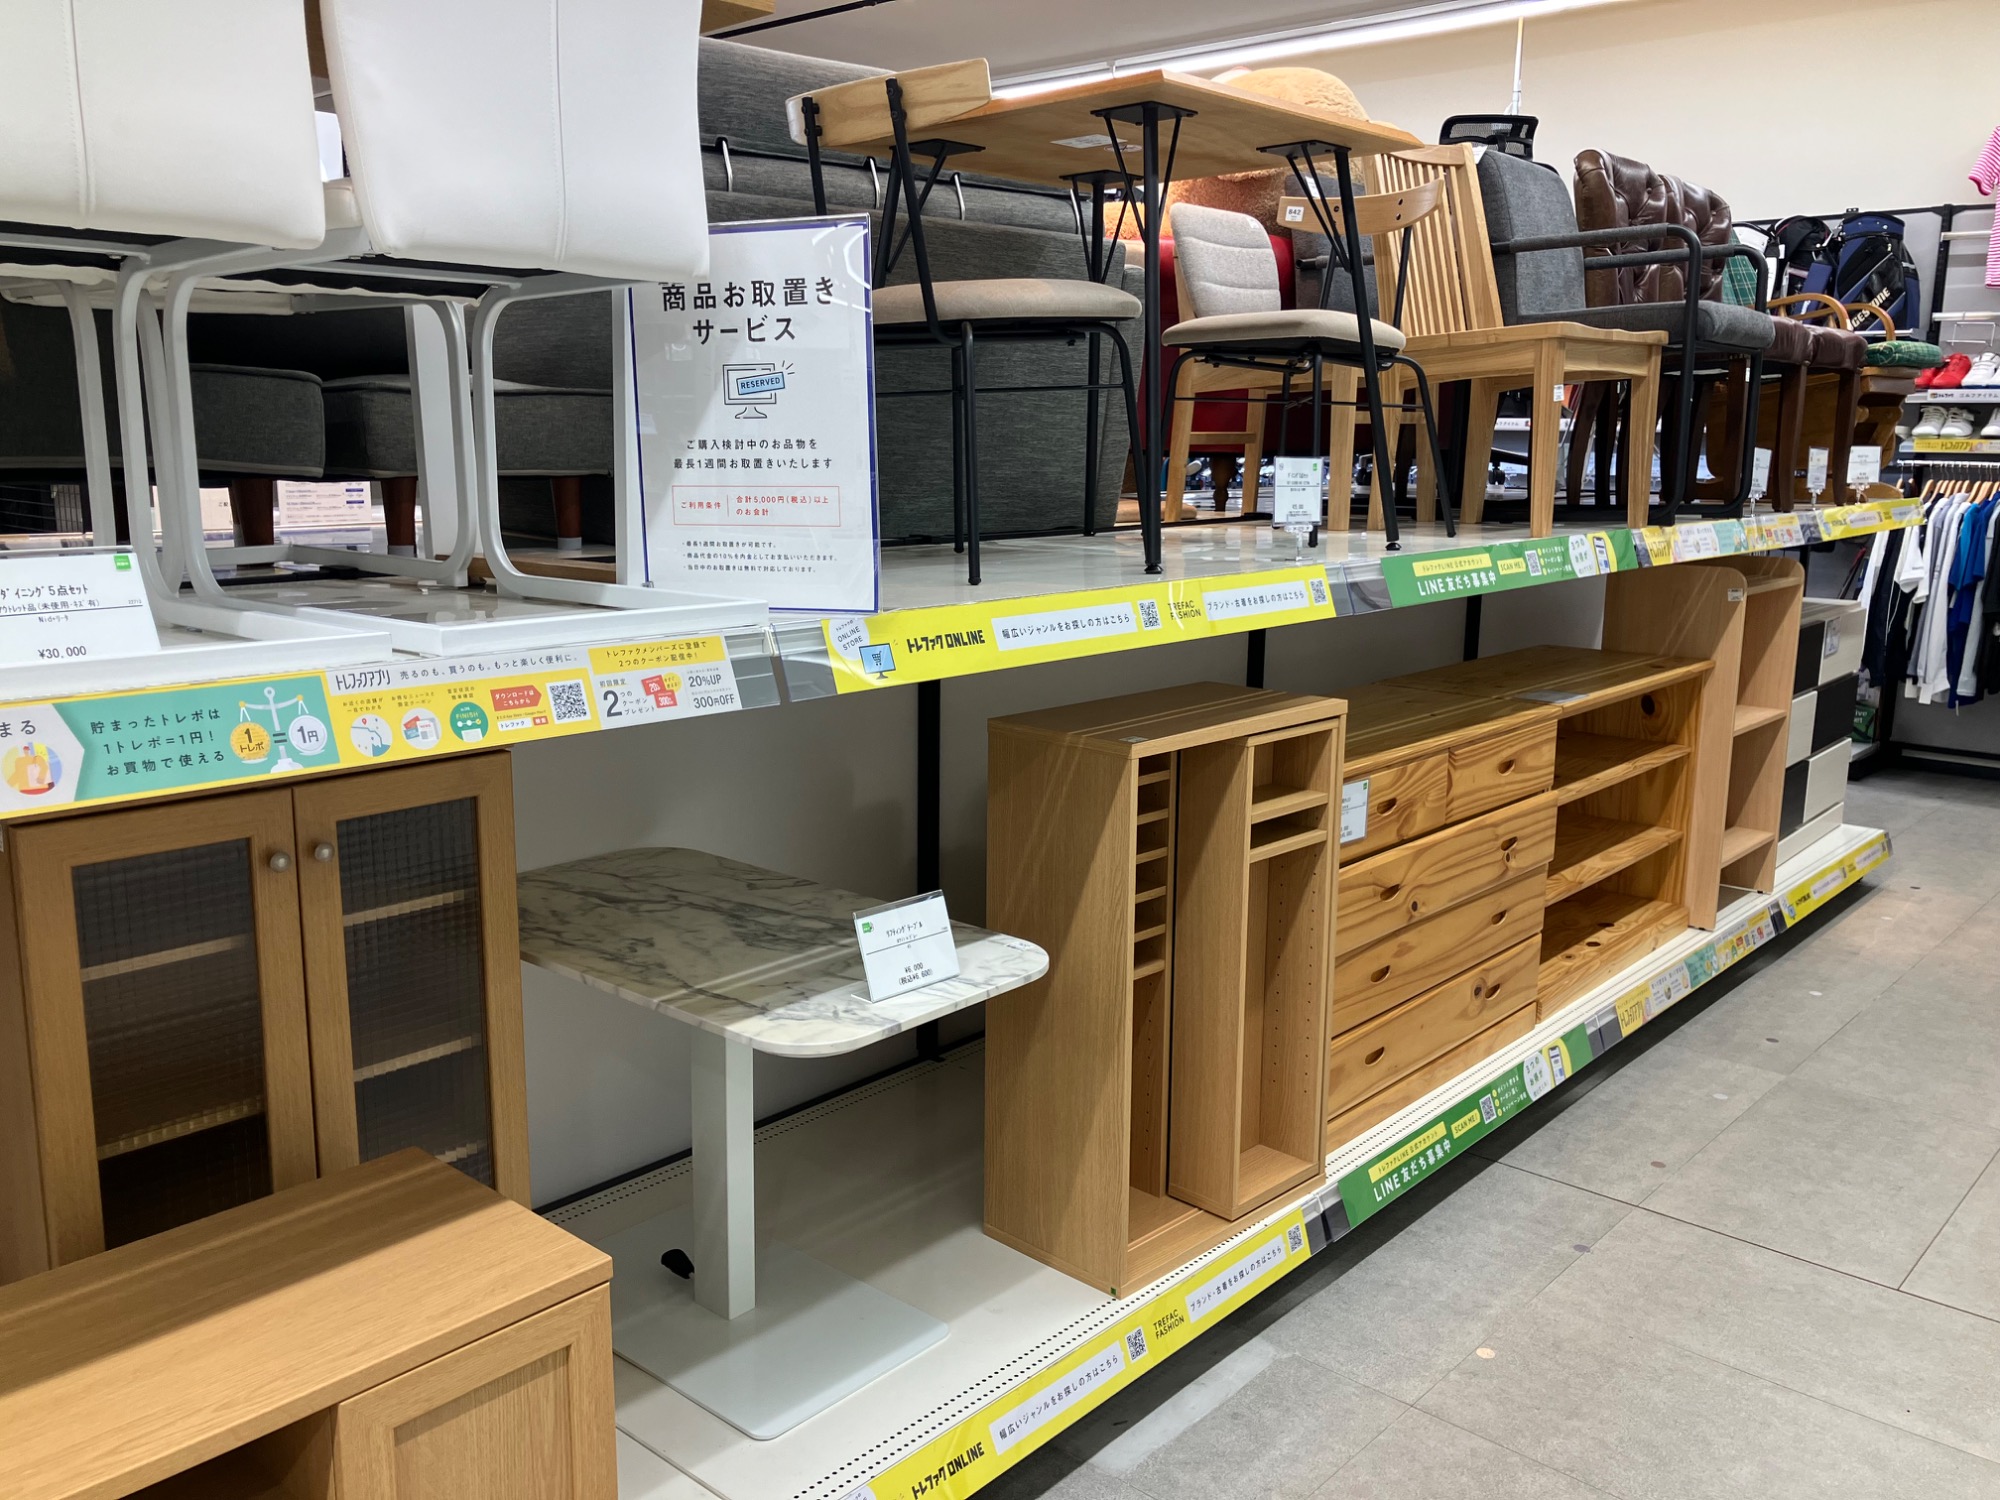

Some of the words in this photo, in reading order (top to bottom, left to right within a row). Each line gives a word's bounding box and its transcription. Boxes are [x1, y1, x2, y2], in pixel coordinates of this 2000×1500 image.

[661, 276, 834, 311] 商品お取置き
[692, 314, 796, 345] サービス
[740, 377, 781, 390] RESERVED
[687, 438, 818, 450] ご購入検討中のお品物を
[673, 457, 833, 470] 最長1週間お取置きいたします
[680, 501, 722, 510] ご利用条件
[735, 495, 830, 505] 合計5,000円(税込)以上
[735, 508, 770, 517] のお会計
[1500, 560, 1513, 573] SCAN
[1417, 579, 1446, 596] LINE
[1445, 570, 1497, 591] 友だち募集中
[1167, 600, 1195, 611] TREFAC
[1207, 590, 1305, 611] ブランド・古着をお探しの方はこちら
[837, 626, 861, 642] ONLINE
[1001, 612, 1130, 640] 幅広いジャンルをお探しの方はこちら
[606, 641, 708, 658] トレファクメンバーズに登録で
[842, 636, 864, 651] STORE
[906, 634, 944, 653] トレファク
[946, 629, 985, 650] ONLINE
[335, 669, 391, 691] トレファクアプリ
[688, 674, 722, 688] 20%UP
[620, 690, 633, 698] つの
[622, 698, 649, 706] クーポン
[692, 694, 735, 709] 300円OFF
[603, 690, 622, 717] 2
[624, 705, 656, 715] プレゼント
[90, 708, 221, 735] 貯まったトレポは
[455, 711, 479, 720] FINISH
[0, 718, 36, 735] まる
[500, 720, 525, 729] トレファク
[243, 727, 253, 744] 1
[296, 725, 320, 744] 1円
[239, 740, 265, 753] トレポ
[106, 749, 226, 777] お買物で使える
[1454, 1121, 1468, 1134] SCAN
[1373, 1173, 1401, 1202] LINE
[1400, 1138, 1451, 1183] 友だち募集中
[1190, 1245, 1283, 1312] ブランド・古着をお探しの方はこちら
[1153, 1309, 1179, 1331] TREFAC
[1155, 1315, 1185, 1340] FASHION
[999, 1353, 1119, 1440] 幅広いジャンルをお探しの方はこちら
[948, 1441, 985, 1476] ONLINE
